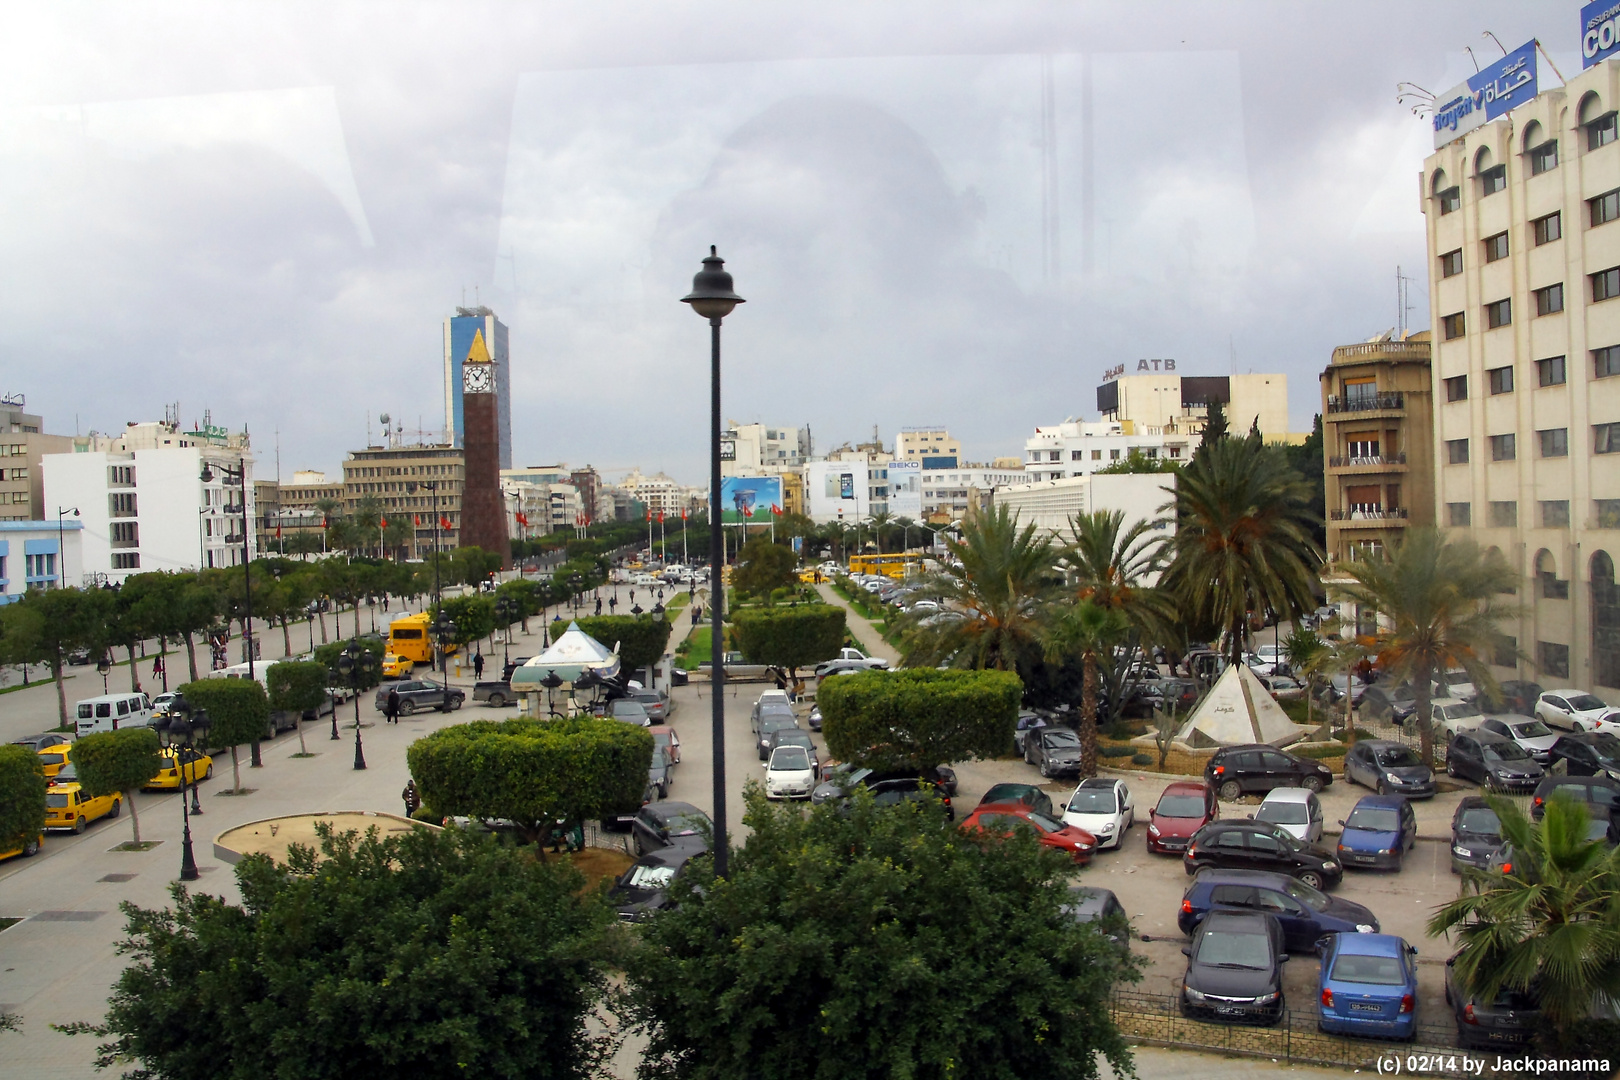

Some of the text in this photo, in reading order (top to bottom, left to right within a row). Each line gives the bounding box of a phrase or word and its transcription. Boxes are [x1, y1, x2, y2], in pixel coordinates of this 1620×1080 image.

[1485, 70, 1533, 103] حياة
[1137, 358, 1176, 371] ATB
[888, 461, 919, 469] BEKO
